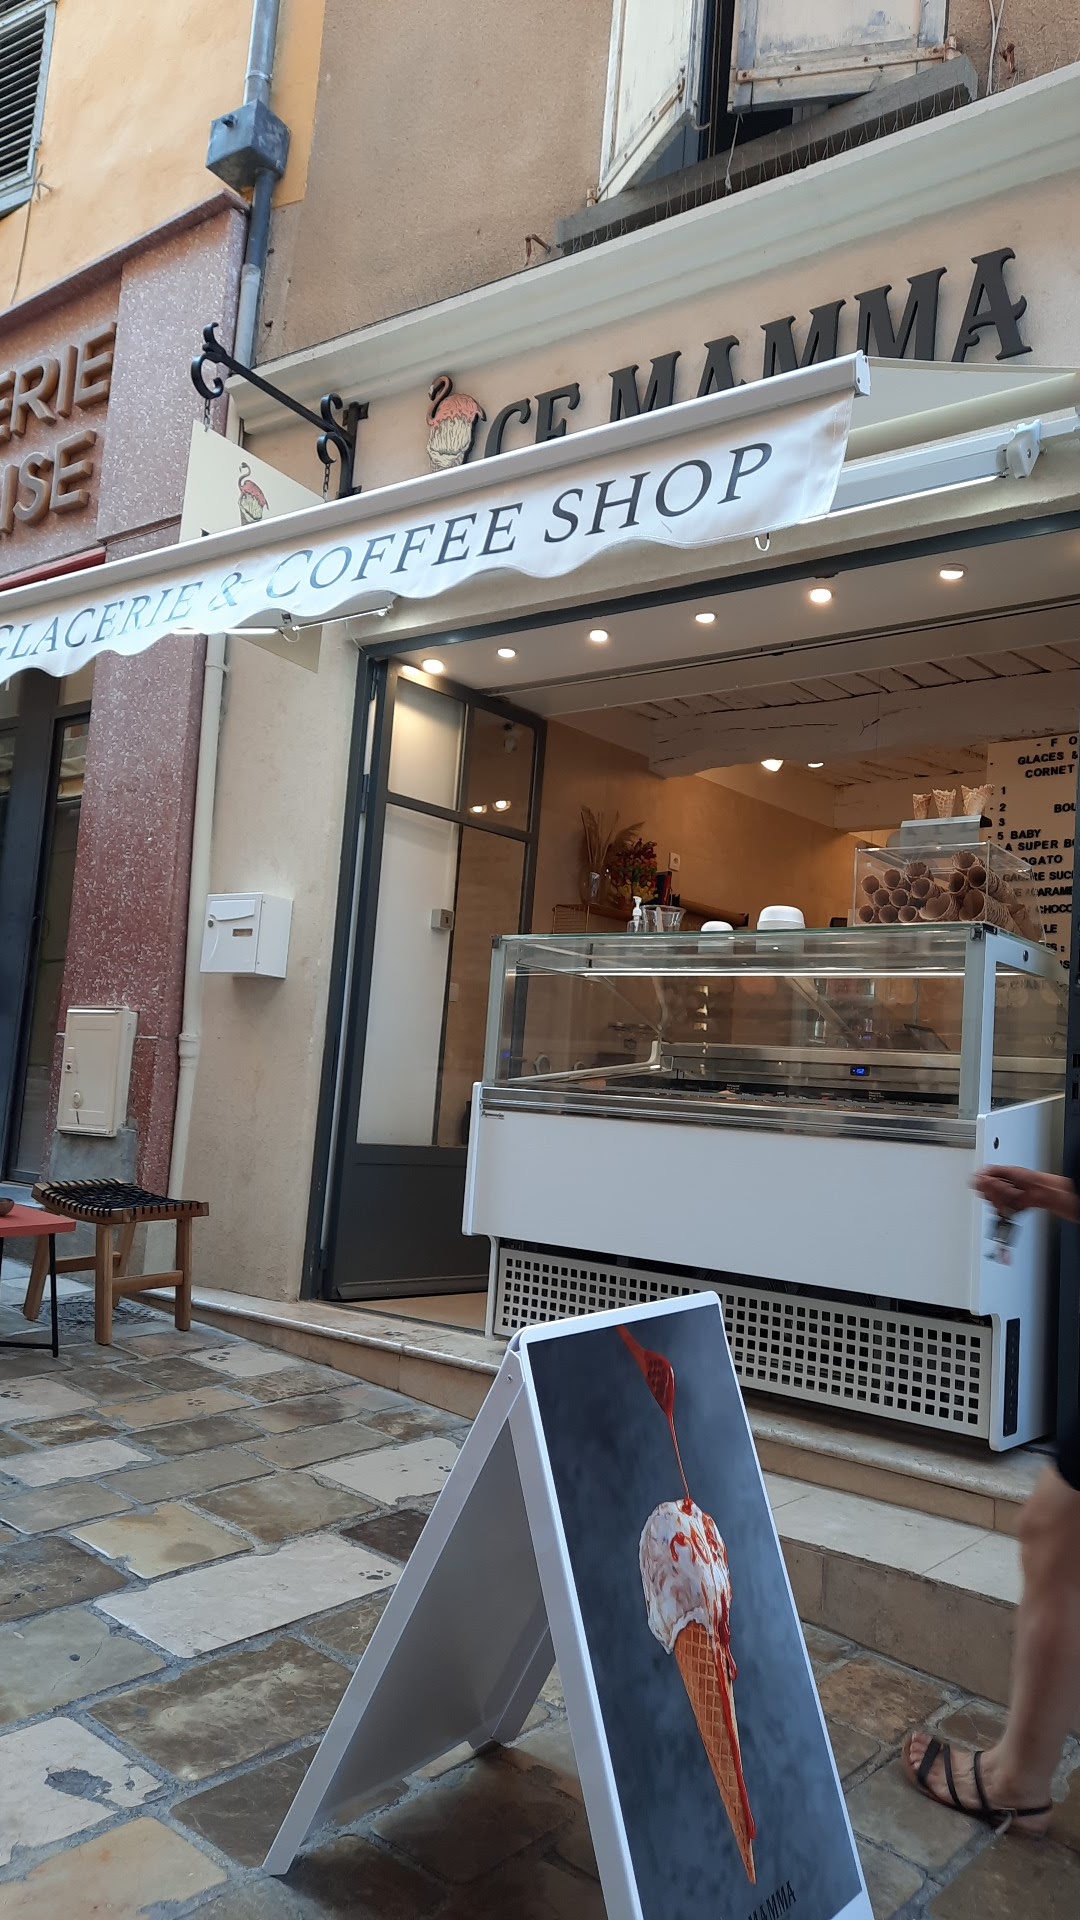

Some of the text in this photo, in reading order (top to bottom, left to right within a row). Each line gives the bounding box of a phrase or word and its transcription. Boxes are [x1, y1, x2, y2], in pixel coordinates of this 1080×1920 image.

[608, 246, 1033, 426] MAMMA
[207, 571, 256, 612] &
[265, 502, 523, 600] COFFEE
[543, 442, 774, 543] SHOP
[1017, 752, 1064, 765] GLACES
[1025, 764, 1075, 778] CORNET
[1001, 786, 1006, 795] 1
[999, 803, 1006, 812] 2
[998, 818, 1006, 827] 3
[997, 829, 1041, 840] 5 BABY
[1018, 840, 1059, 851] SUPER
[1064, 838, 1075, 849] B
